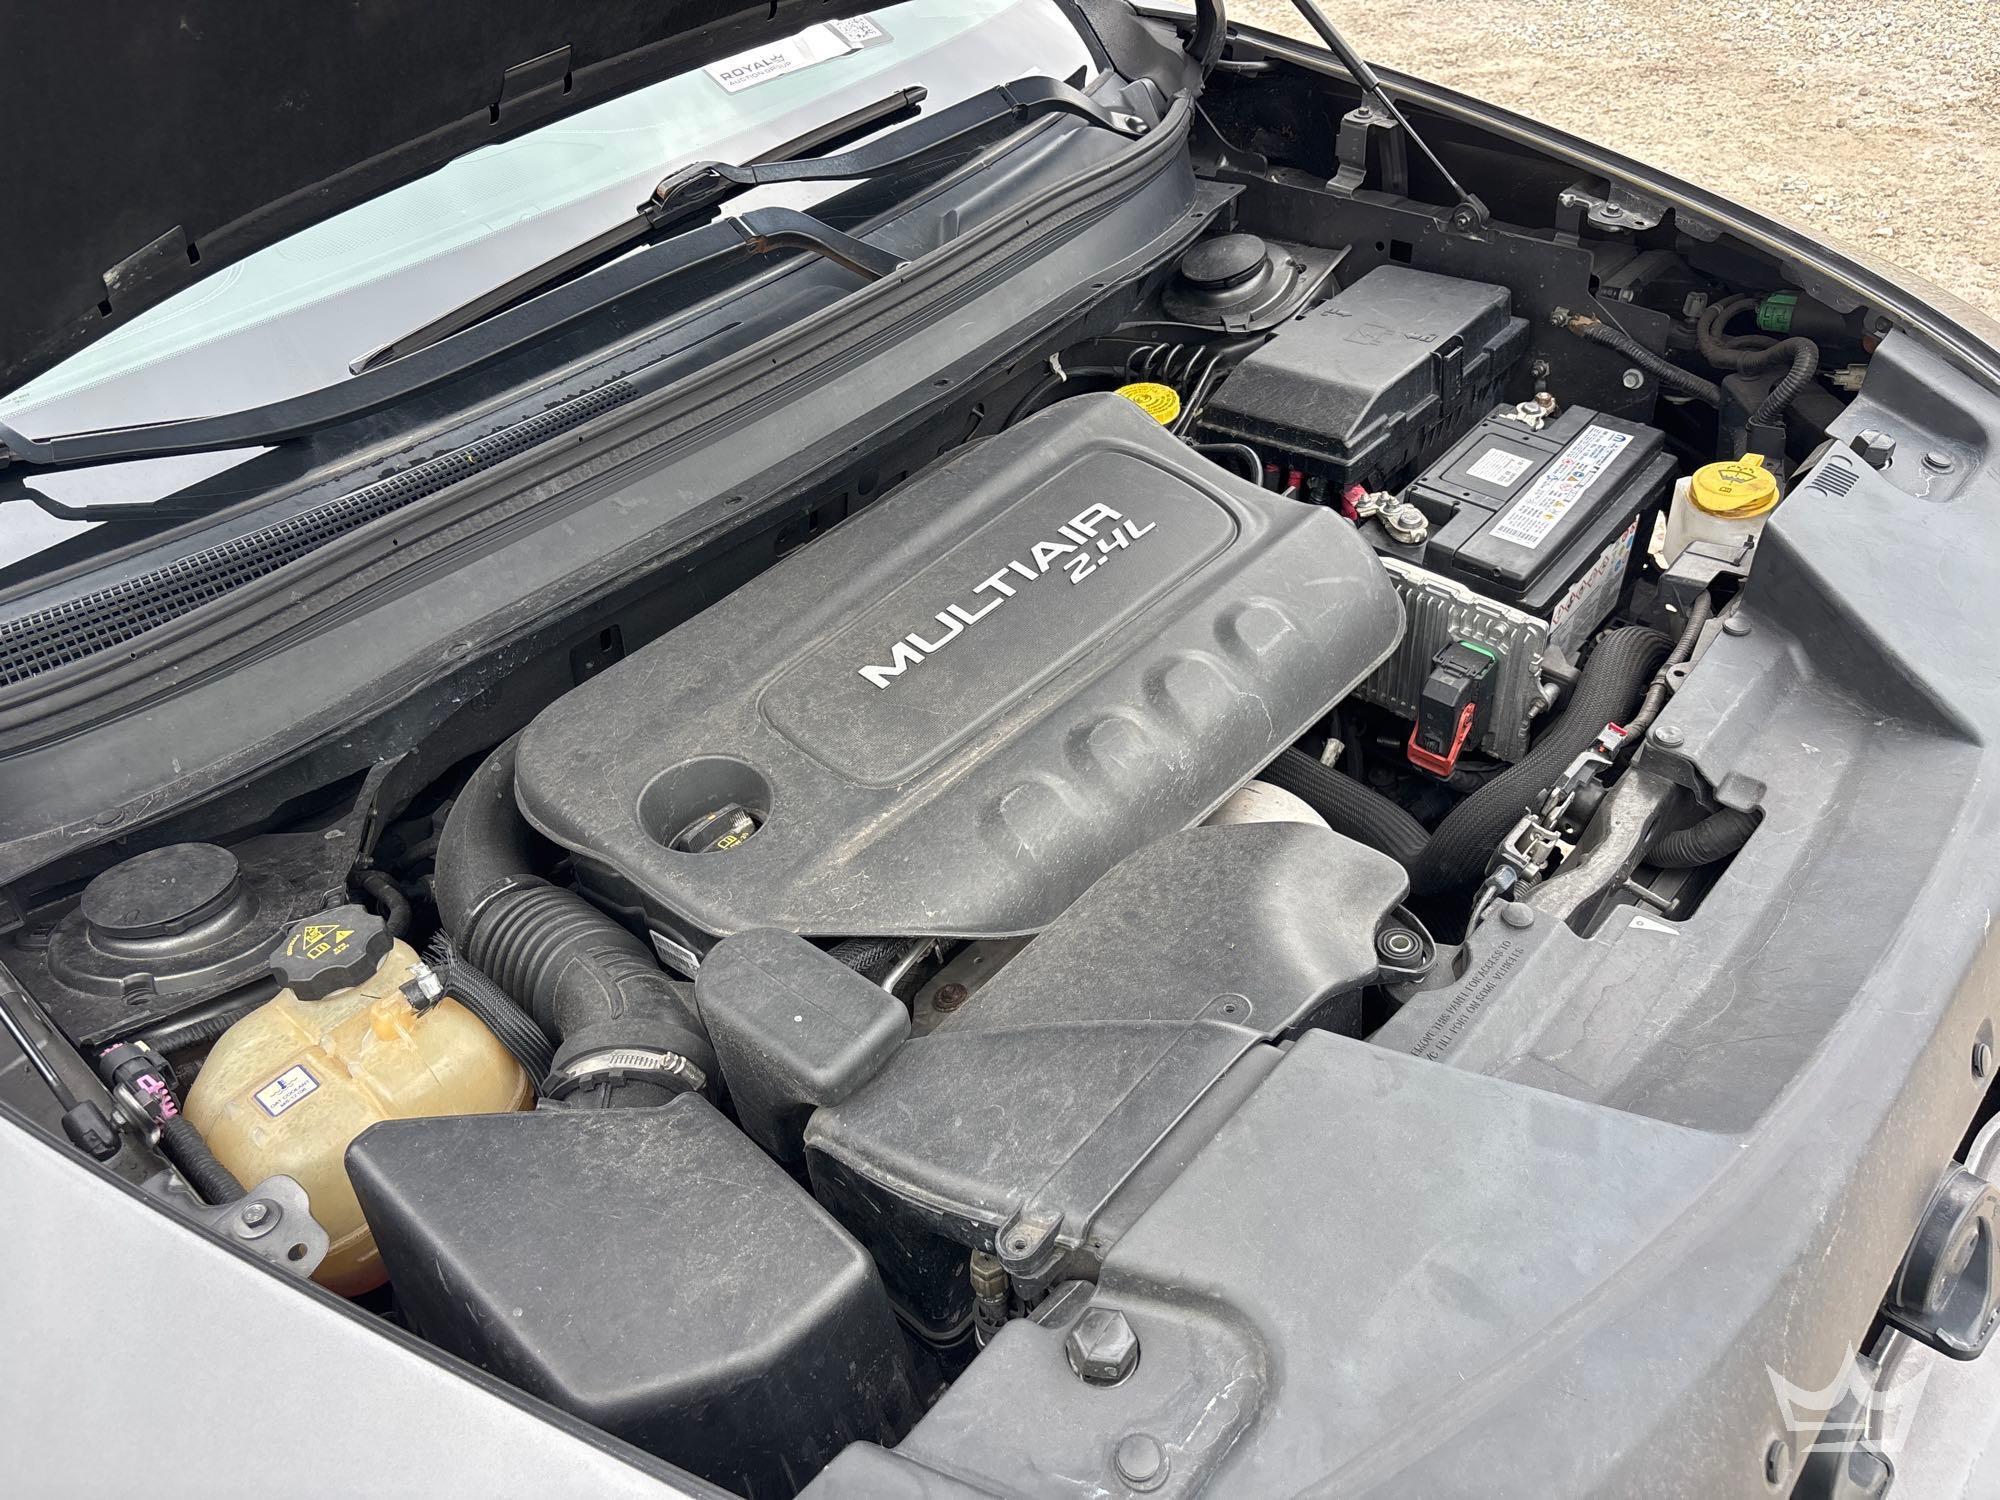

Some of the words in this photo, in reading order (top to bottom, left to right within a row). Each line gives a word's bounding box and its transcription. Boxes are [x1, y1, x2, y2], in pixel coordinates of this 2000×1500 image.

[720, 59, 773, 80] ROYAL
[730, 70, 765, 85] AUCTION
[1063, 519, 1157, 585] 2.4L
[857, 502, 1123, 690] MULTIAIR
[1410, 1030, 1435, 1057] EMOVE
[1432, 1012, 1450, 1031] THIS
[1446, 991, 1469, 1015] PANEL
[1464, 976, 1482, 992] FOR
[1478, 949, 1504, 978] ACCESS
[1499, 940, 1512, 951] TO
[1435, 1034, 1452, 1051] FILL
[1449, 1012, 1470, 1034] PORT
[1466, 1000, 1481, 1014] ON
[1476, 981, 1497, 1002] SOME
[1492, 947, 1524, 981] VEHICLES
